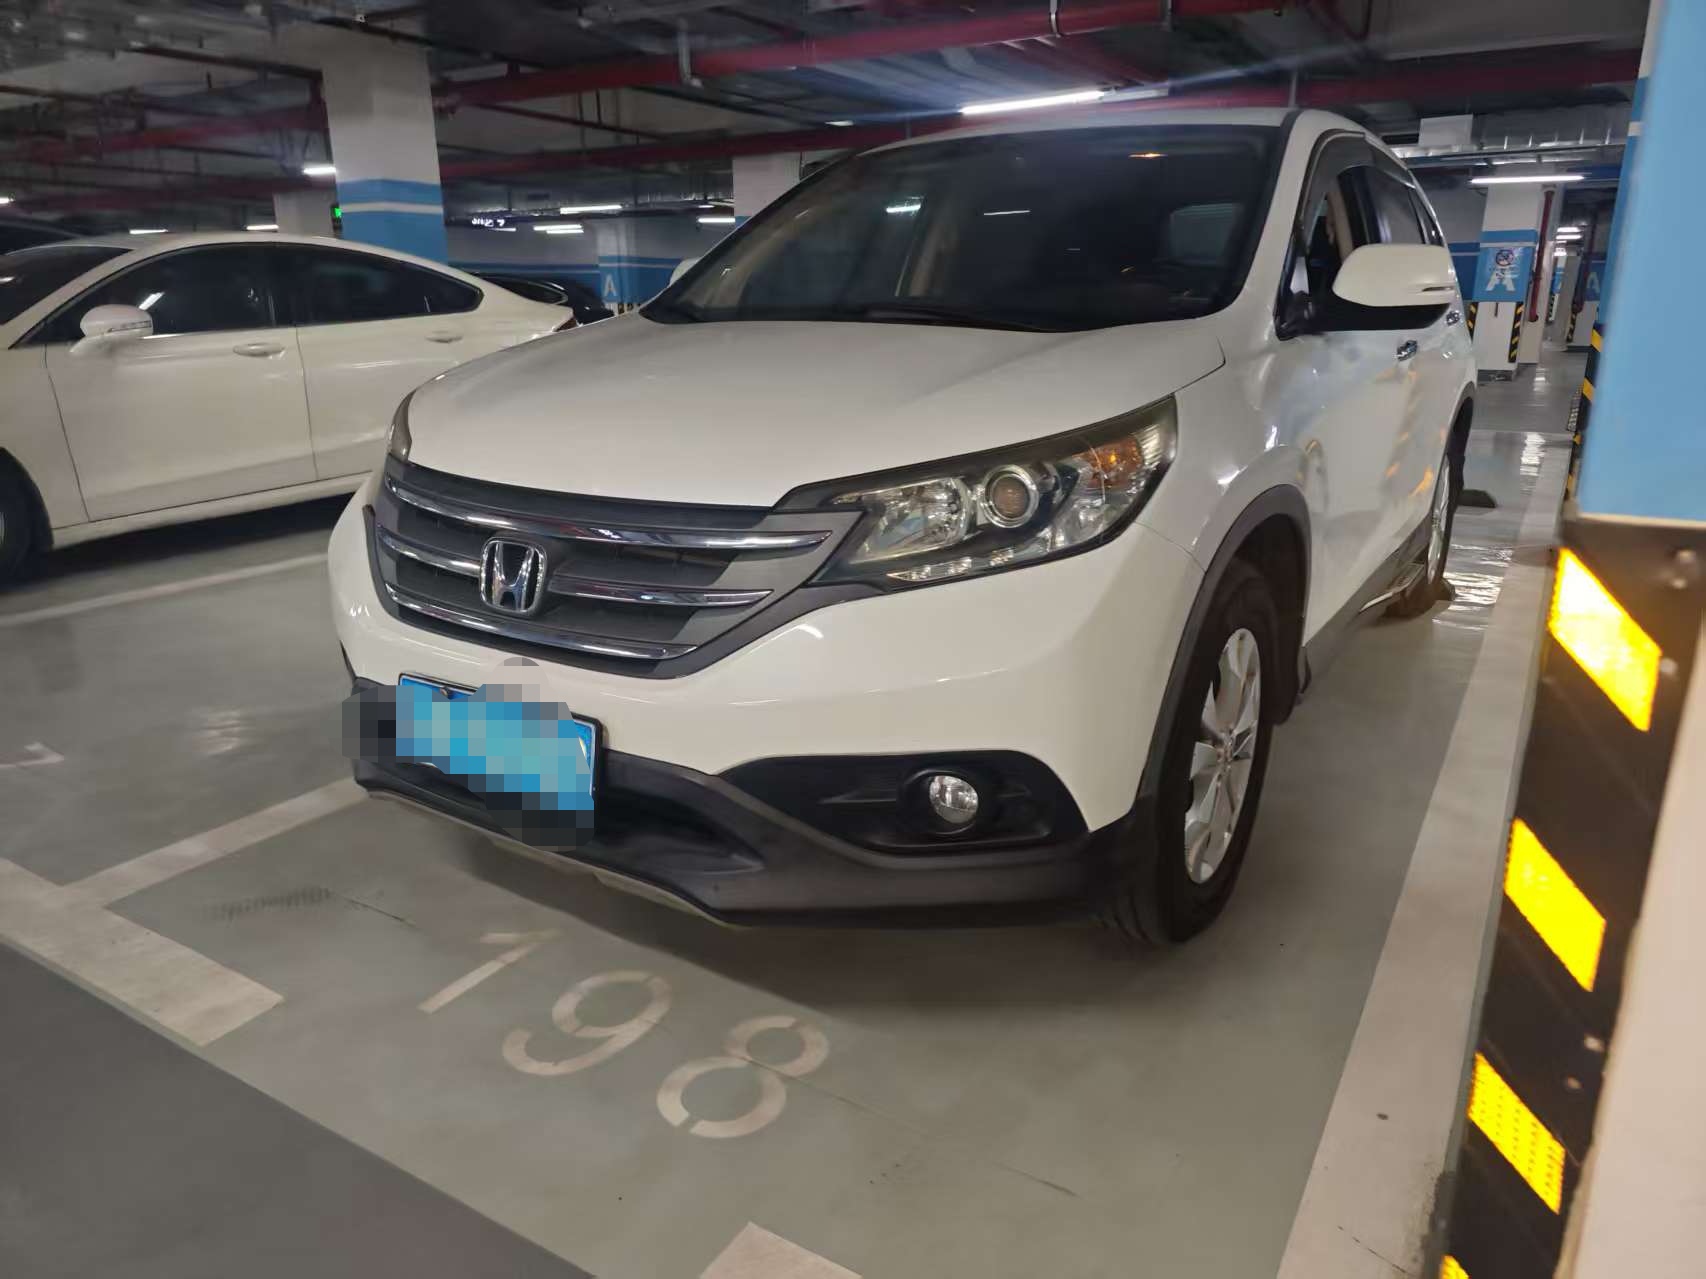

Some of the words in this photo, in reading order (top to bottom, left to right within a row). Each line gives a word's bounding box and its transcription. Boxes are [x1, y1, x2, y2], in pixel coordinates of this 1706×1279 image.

[603, 274, 617, 297] A
[1485, 266, 1516, 291] A
[416, 928, 830, 1139] 198
